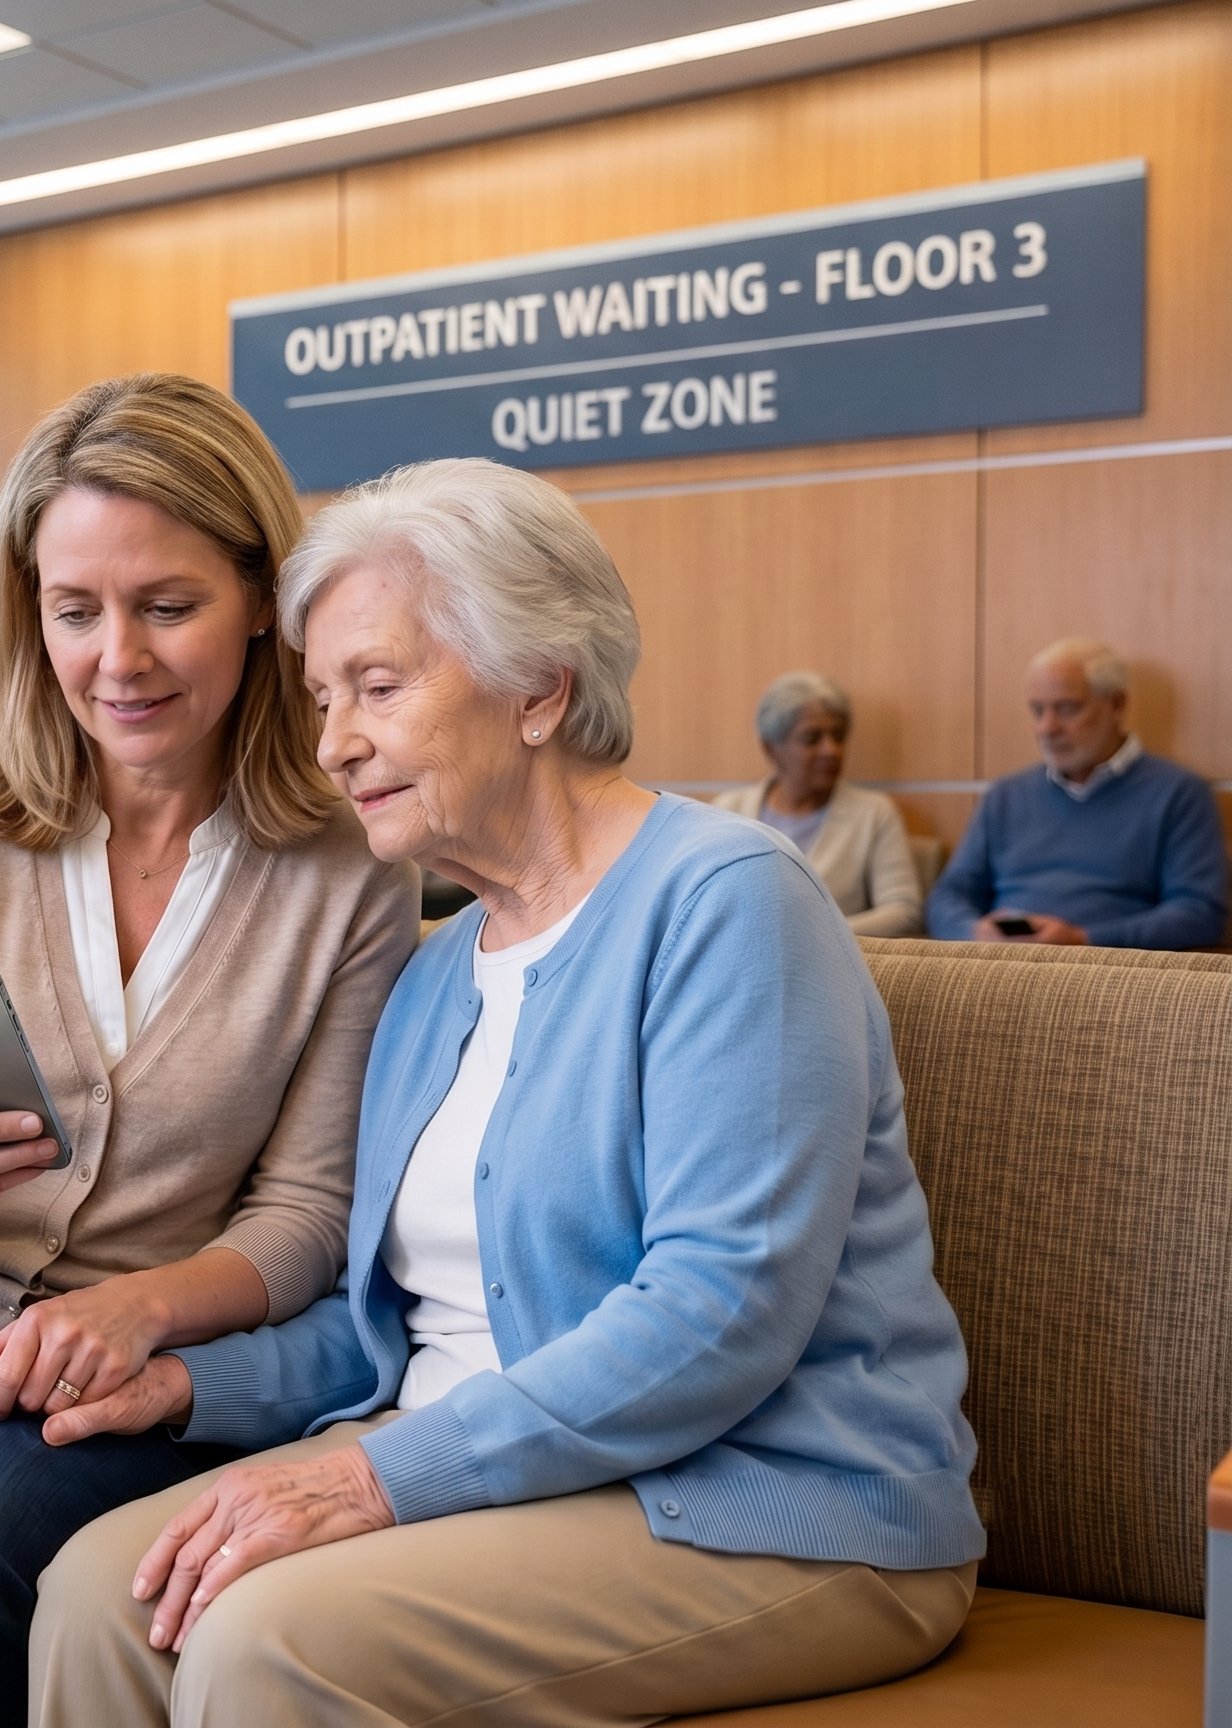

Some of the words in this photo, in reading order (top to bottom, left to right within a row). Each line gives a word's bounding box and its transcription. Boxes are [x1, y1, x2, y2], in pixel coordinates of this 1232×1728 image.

[284, 293, 547, 376] OUTPATIENT
[553, 261, 768, 340] WAITING
[779, 279, 802, 295] -
[815, 227, 998, 305] FLOOR
[1012, 221, 1048, 279] 3
[491, 386, 631, 452] QUIET
[641, 369, 778, 434] ZONE
